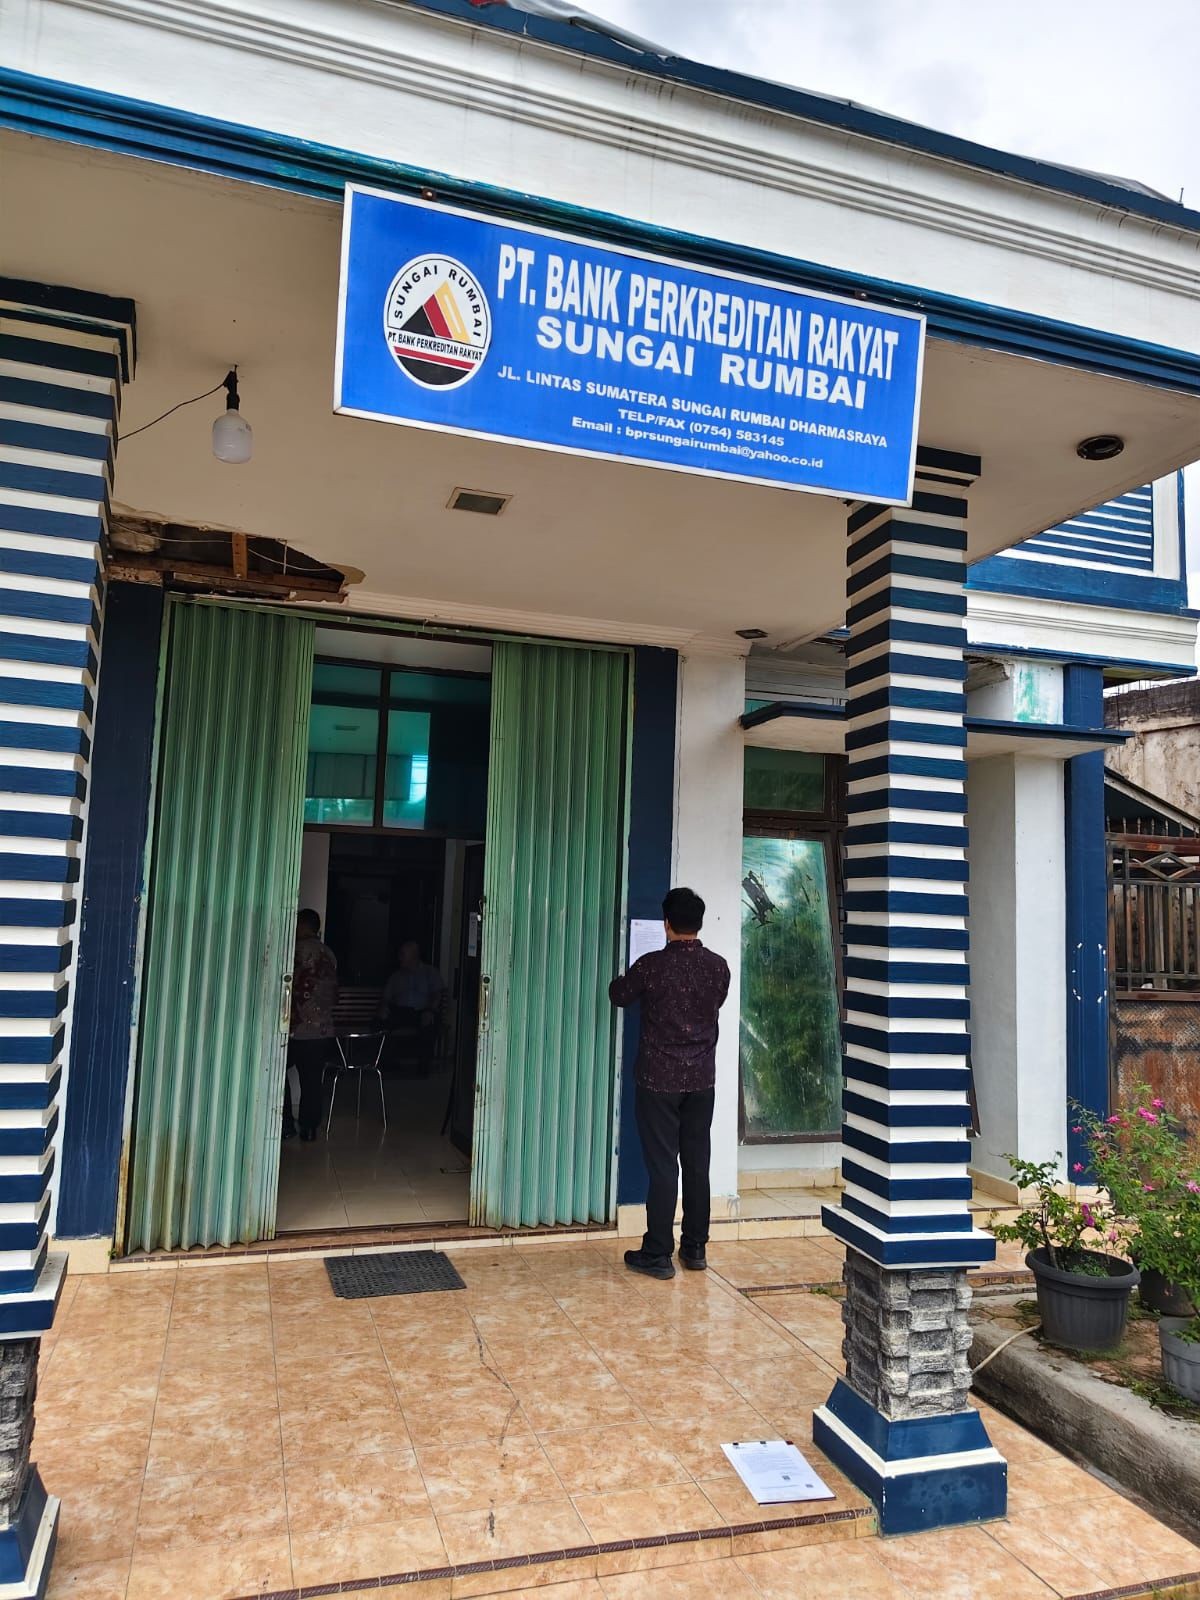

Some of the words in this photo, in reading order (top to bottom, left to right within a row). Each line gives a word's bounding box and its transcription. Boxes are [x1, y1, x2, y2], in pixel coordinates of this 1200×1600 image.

[394, 265, 438, 319] SUNGAI
[448, 269, 482, 337] RUMBAI
[498, 244, 535, 305] PT.
[545, 254, 622, 324] BANK
[628, 273, 801, 360] PERKREDITAN
[807, 313, 899, 380] RAKYAT
[398, 334, 416, 347] BANK
[416, 339, 459, 356] PERKREDITAN
[459, 348, 483, 361] RAKYAT
[536, 316, 695, 376] SUNGAI
[720, 353, 866, 409] RUMBAI
[497, 366, 521, 381] JL.
[526, 370, 582, 392] LINTAS
[586, 382, 667, 408] SUMATERA
[672, 398, 727, 419] SUNGAI
[731, 408, 786, 429] RUMBAI
[789, 419, 888, 448] DHARMASRAYA
[572, 416, 612, 433] Email
[625, 426, 824, 468] bprsungairumbai@yahoo.co.id
[618, 409, 686, 430] TELP/FAX
[689, 421, 732, 440] (0754)
[736, 429, 785, 447] 583145
